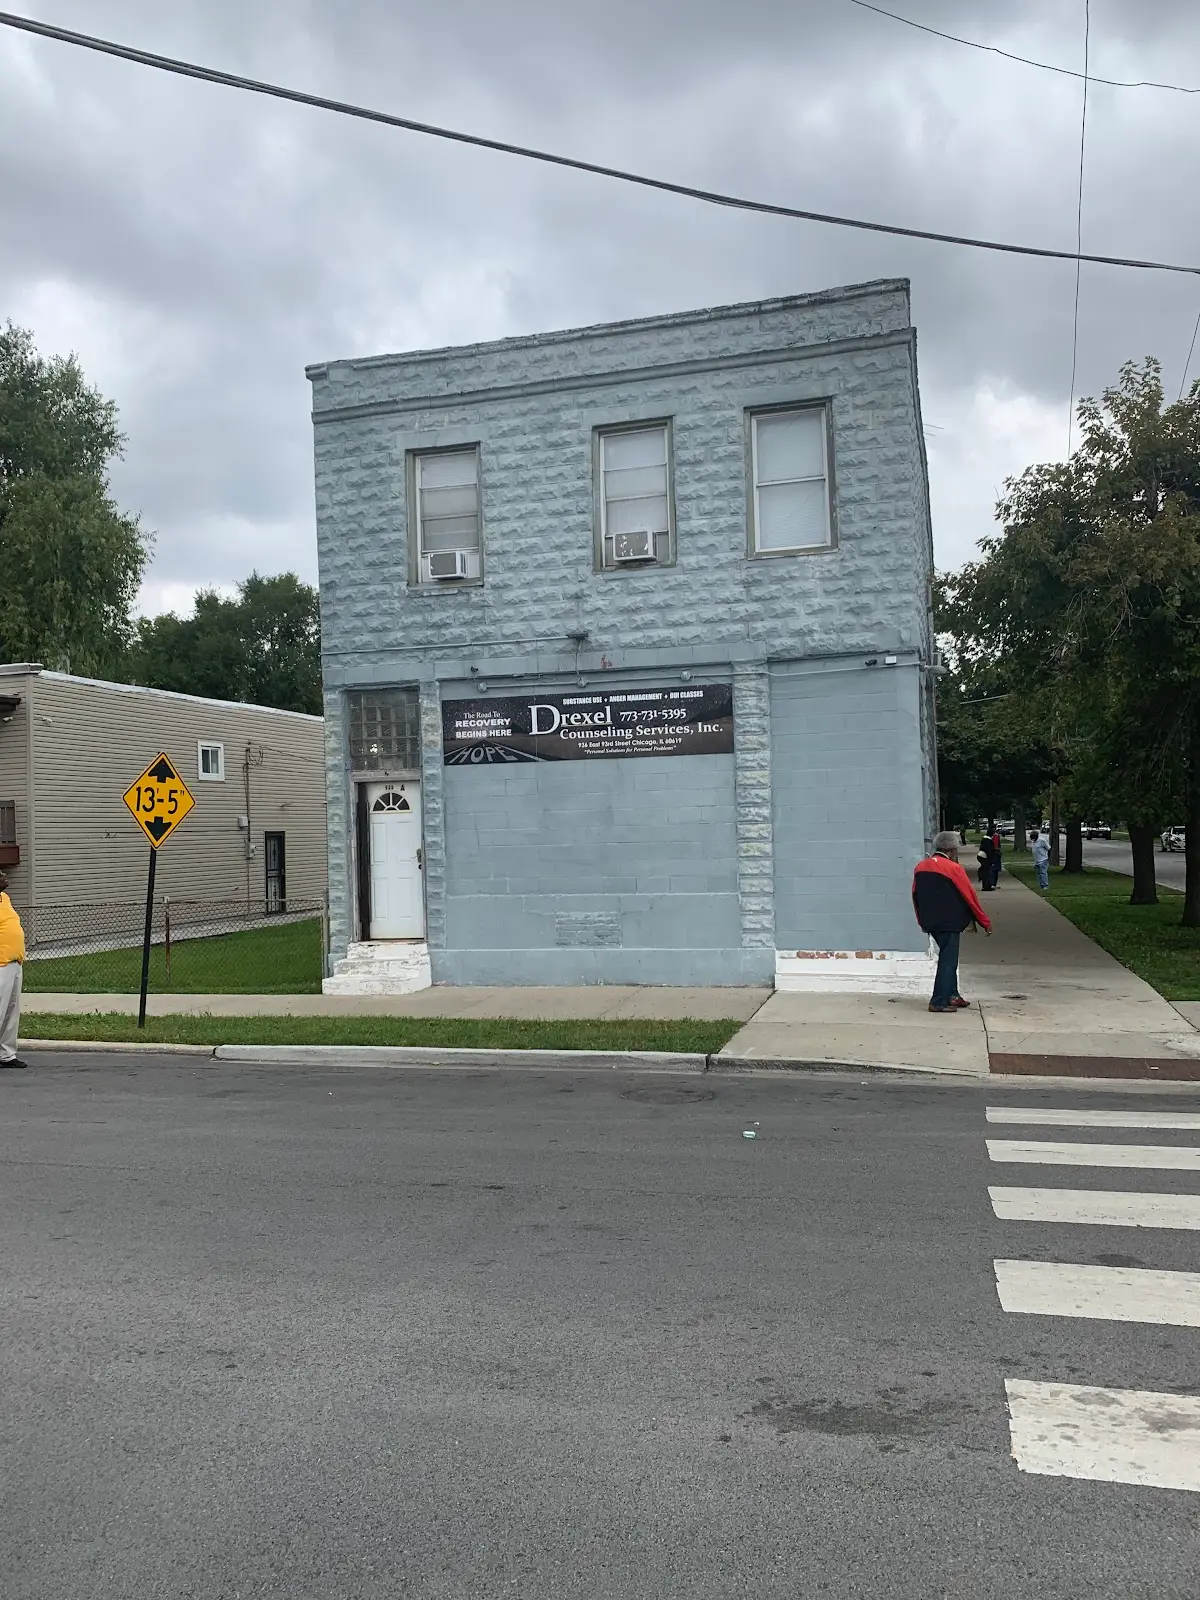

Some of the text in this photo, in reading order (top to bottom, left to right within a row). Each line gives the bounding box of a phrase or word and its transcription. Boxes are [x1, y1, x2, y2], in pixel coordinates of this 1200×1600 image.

[562, 697, 592, 705] SUBSTANCE
[609, 694, 626, 703] ANGER
[627, 693, 662, 702] MANAGEMENT
[669, 691, 680, 699] DUI
[680, 690, 704, 699] CLASSES
[476, 711, 490, 719] Road
[528, 705, 613, 735] Drexel
[620, 708, 687, 722] 773-731-5395
[455, 718, 511, 728] RECOVERY
[455, 729, 512, 739] BEGINS HERE
[559, 721, 724, 740] Counseling Services, Inc.
[614, 739, 631, 747] Street
[625, 746, 633, 754] for
[448, 746, 519, 764] HOPE
[136, 786, 185, 815] 13'-5"
